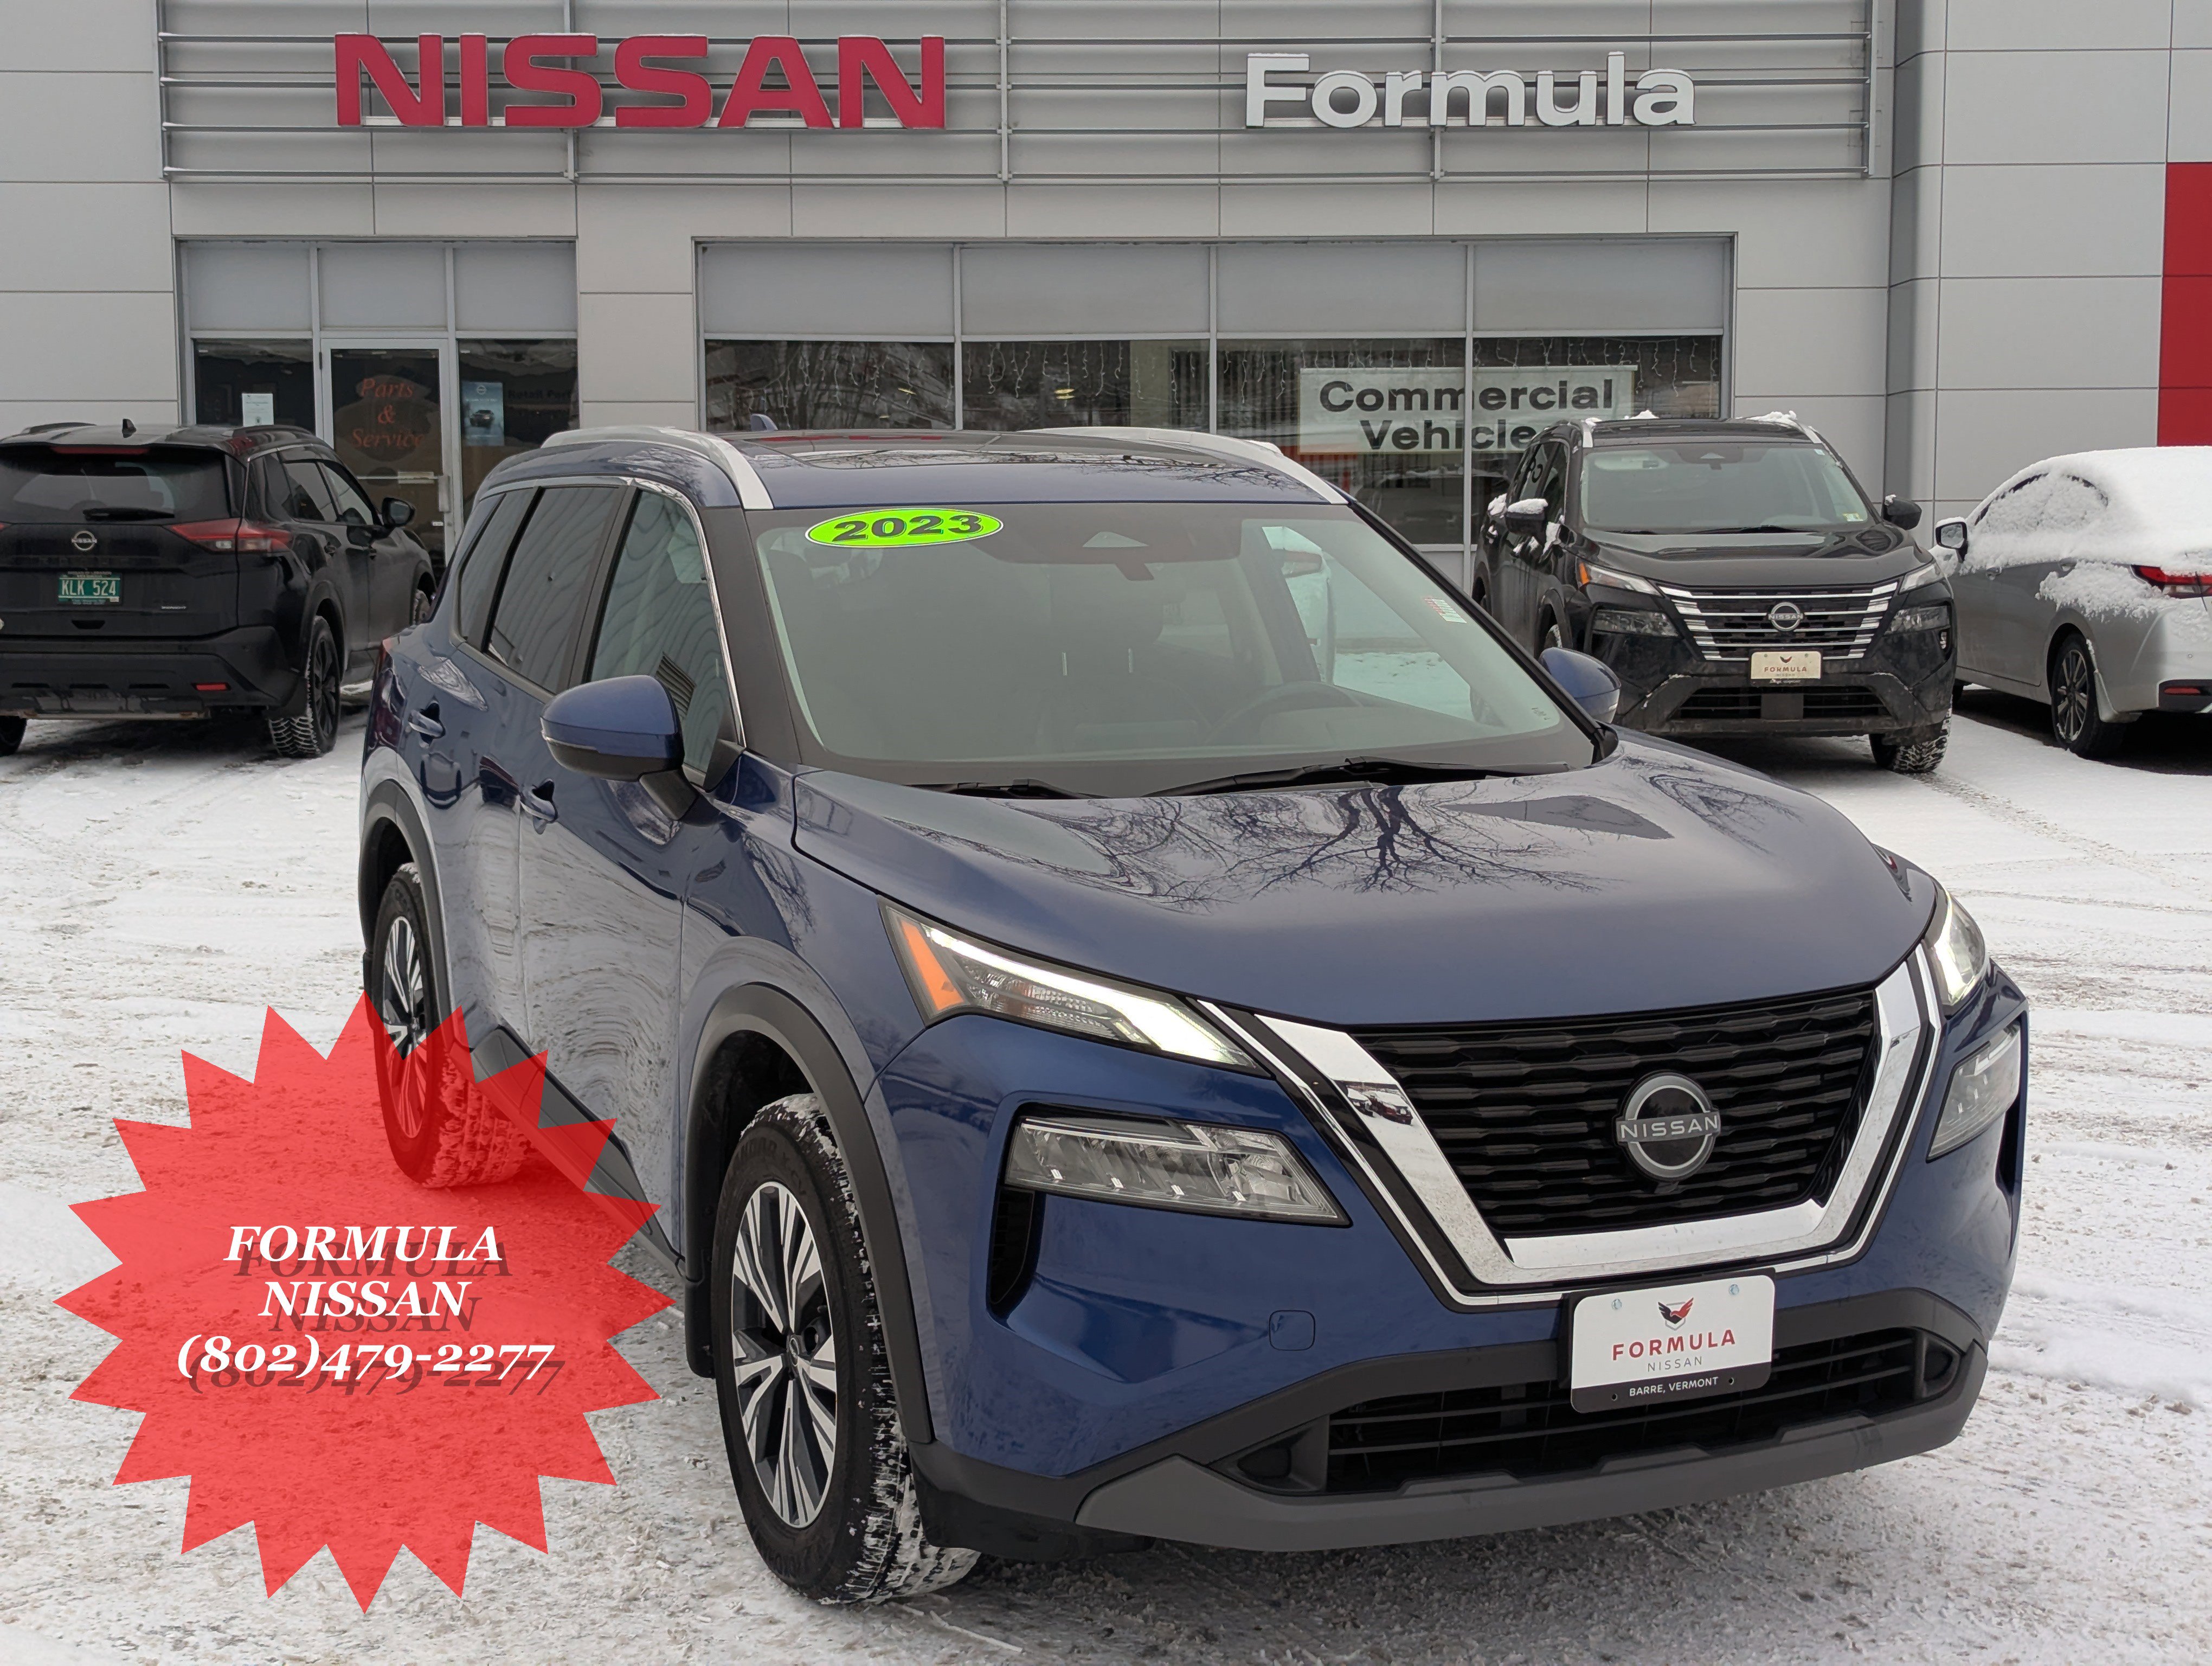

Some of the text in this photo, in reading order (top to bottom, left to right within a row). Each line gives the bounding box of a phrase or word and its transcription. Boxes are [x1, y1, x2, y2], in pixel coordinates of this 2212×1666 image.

[334, 34, 946, 129] NISSAN
[1245, 51, 1697, 128] Formula
[360, 378, 415, 397] Parts
[1319, 379, 1613, 412] Commercial
[377, 404, 397, 424] &
[352, 428, 425, 448] Service
[1360, 419, 1538, 450] Vehicle
[832, 515, 983, 543] 2023
[61, 580, 116, 595] KLK 524
[1620, 1114, 1719, 1139] NISSAN
[1612, 1329, 1735, 1361] FORMULA
[1647, 1356, 1702, 1372] NISSAN
[1629, 1376, 1719, 1397] BARRE, VERMONT
